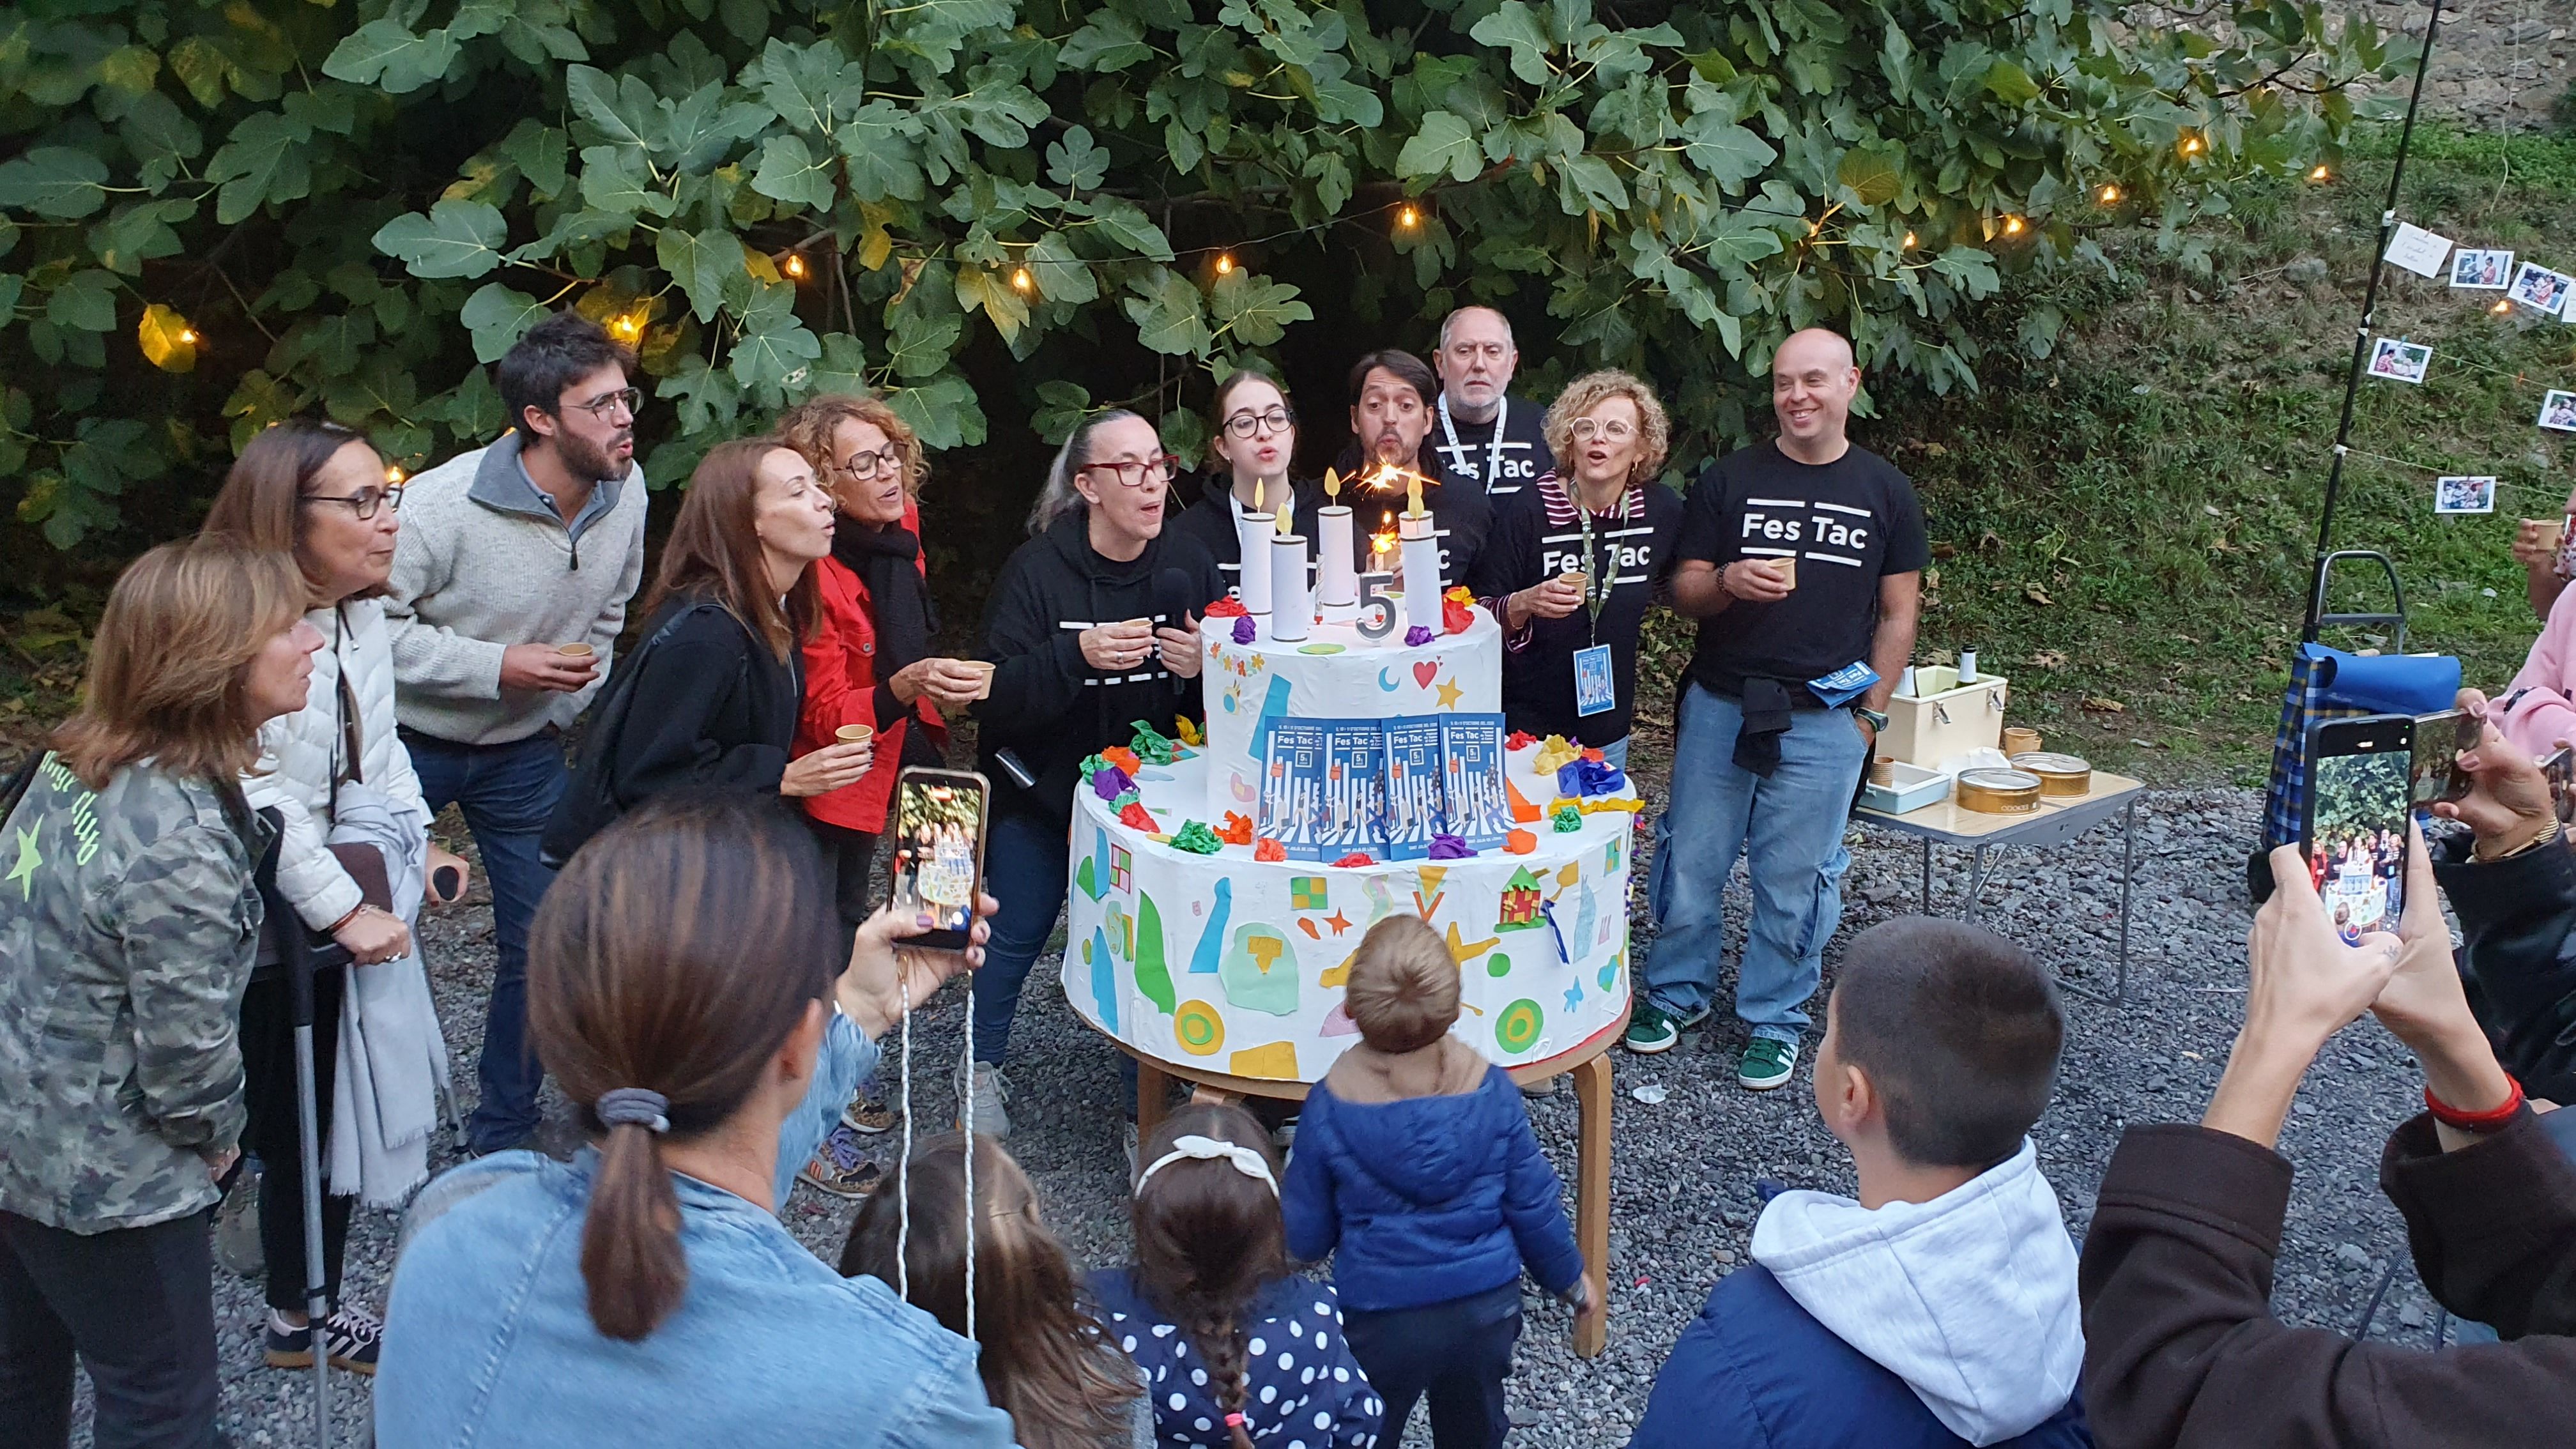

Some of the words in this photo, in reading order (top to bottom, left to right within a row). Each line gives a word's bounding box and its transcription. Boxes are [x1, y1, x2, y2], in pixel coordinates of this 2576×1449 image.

[1742, 513, 1802, 541] Fes
[1811, 516, 1867, 549] Tac
[1355, 571, 1397, 642] 5
[1277, 735, 1294, 744] Fes
[1296, 736, 1313, 745] Tac
[1393, 735, 1407, 744] Fes
[1409, 734, 1423, 742] Tac
[1451, 732, 1464, 740] Fes
[1466, 731, 1479, 739] Tac
[1335, 737, 1351, 746] Fes
[1352, 737, 1368, 745] Tac
[70, 791, 100, 866] club
